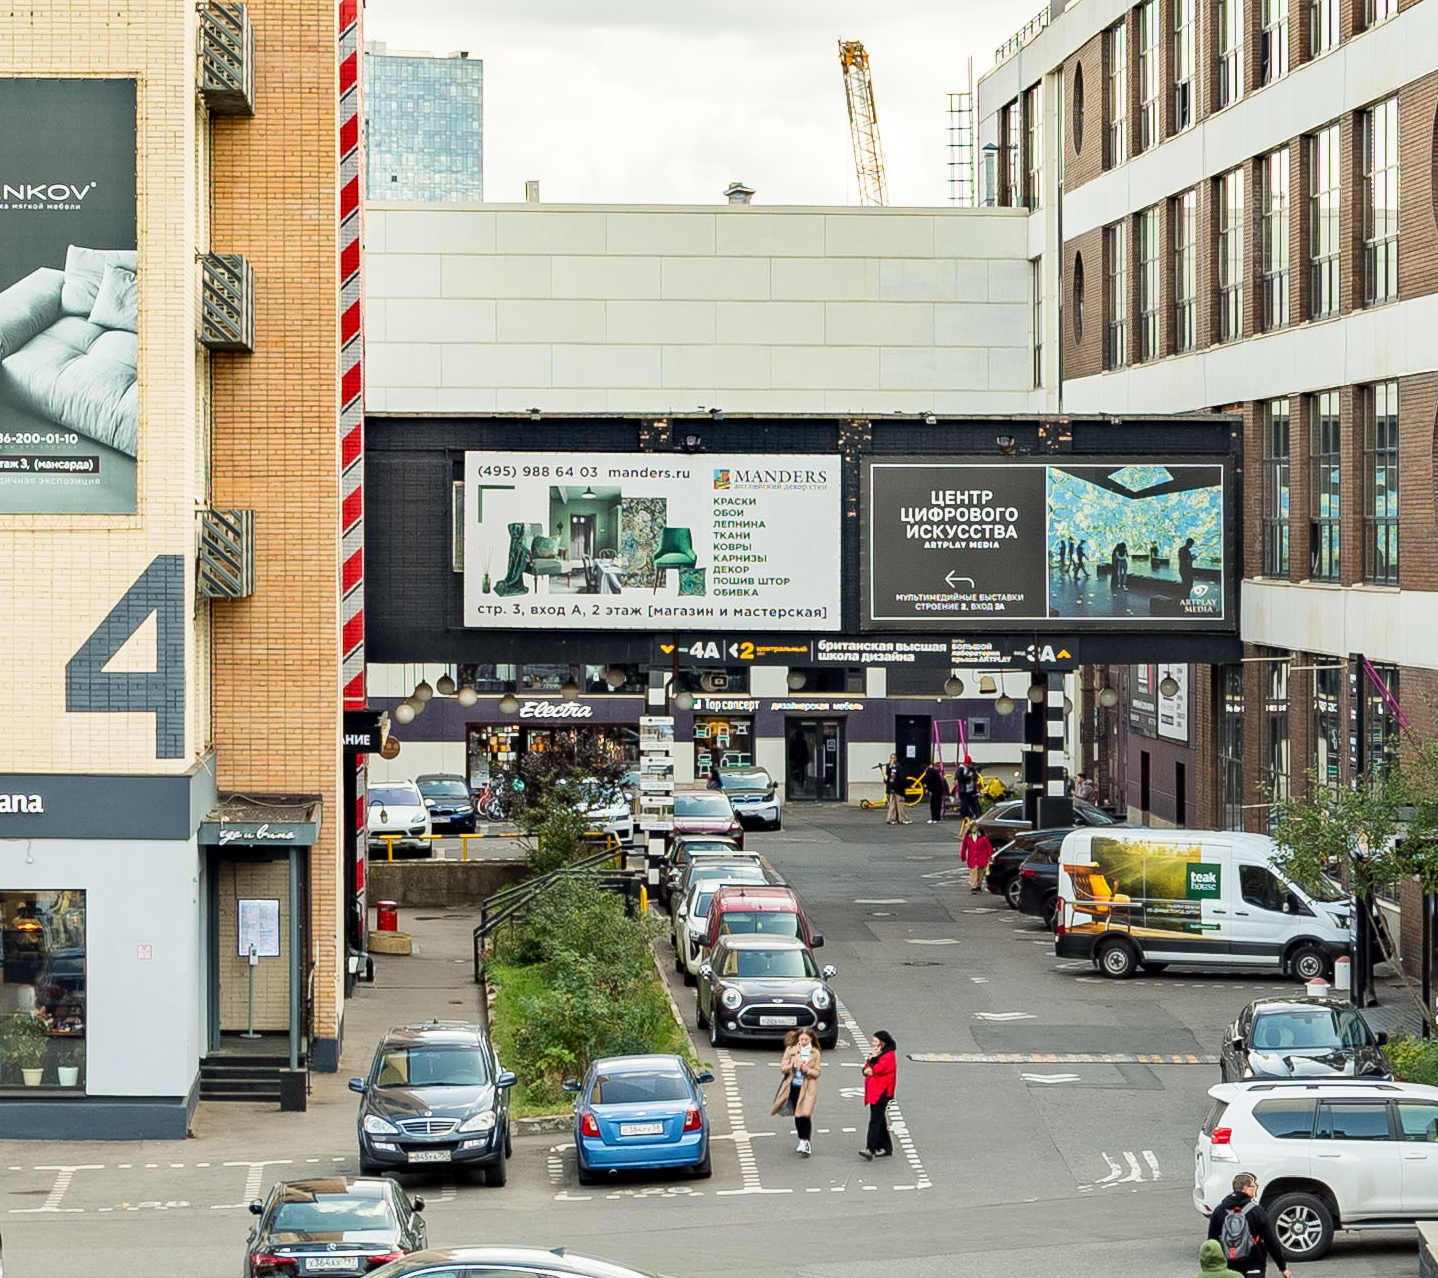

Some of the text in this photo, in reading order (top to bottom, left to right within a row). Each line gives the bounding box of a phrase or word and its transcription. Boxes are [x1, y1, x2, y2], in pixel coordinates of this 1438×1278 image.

[477, 465, 691, 479] (495) 988 64 03 manders.ru
[734, 470, 827, 483] MANDERS
[713, 497, 756, 506] КРАСКИ
[930, 490, 993, 508] ЦЕНТР
[713, 509, 744, 517] ОБОИ
[900, 507, 1018, 525] ЦИФРОВОГО
[713, 520, 766, 529] ЛЕПНИНА
[713, 531, 751, 540] ТКАНИ
[906, 525, 1018, 539] ИСКУССТВА
[713, 543, 752, 551] КОВРЫ
[924, 541, 1000, 549] ARTPLAY MEDIA
[713, 554, 767, 563] КАРНИЗЫ
[713, 565, 749, 575] ДЕКОР
[713, 577, 790, 586] ПОШИВ ШТОР
[713, 588, 759, 597] ОБИВКА
[1180, 598, 1217, 606] ARTPLAY
[477, 606, 506, 617] стр.
[512, 604, 525, 616] 3,
[530, 606, 566, 617] вход
[592, 604, 600, 616] 2
[605, 606, 643, 617] этаж
[648, 605, 713, 618] [магазин
[719, 607, 728, 617] и
[733, 606, 827, 620] мастерская]
[740, 642, 754, 659] 2
[817, 640, 947, 653] британская высшая
[64, 554, 185, 759] 4
[817, 652, 916, 662] школа дизайна
[519, 701, 593, 719] Electra
[1190, 871, 1216, 883] teak
